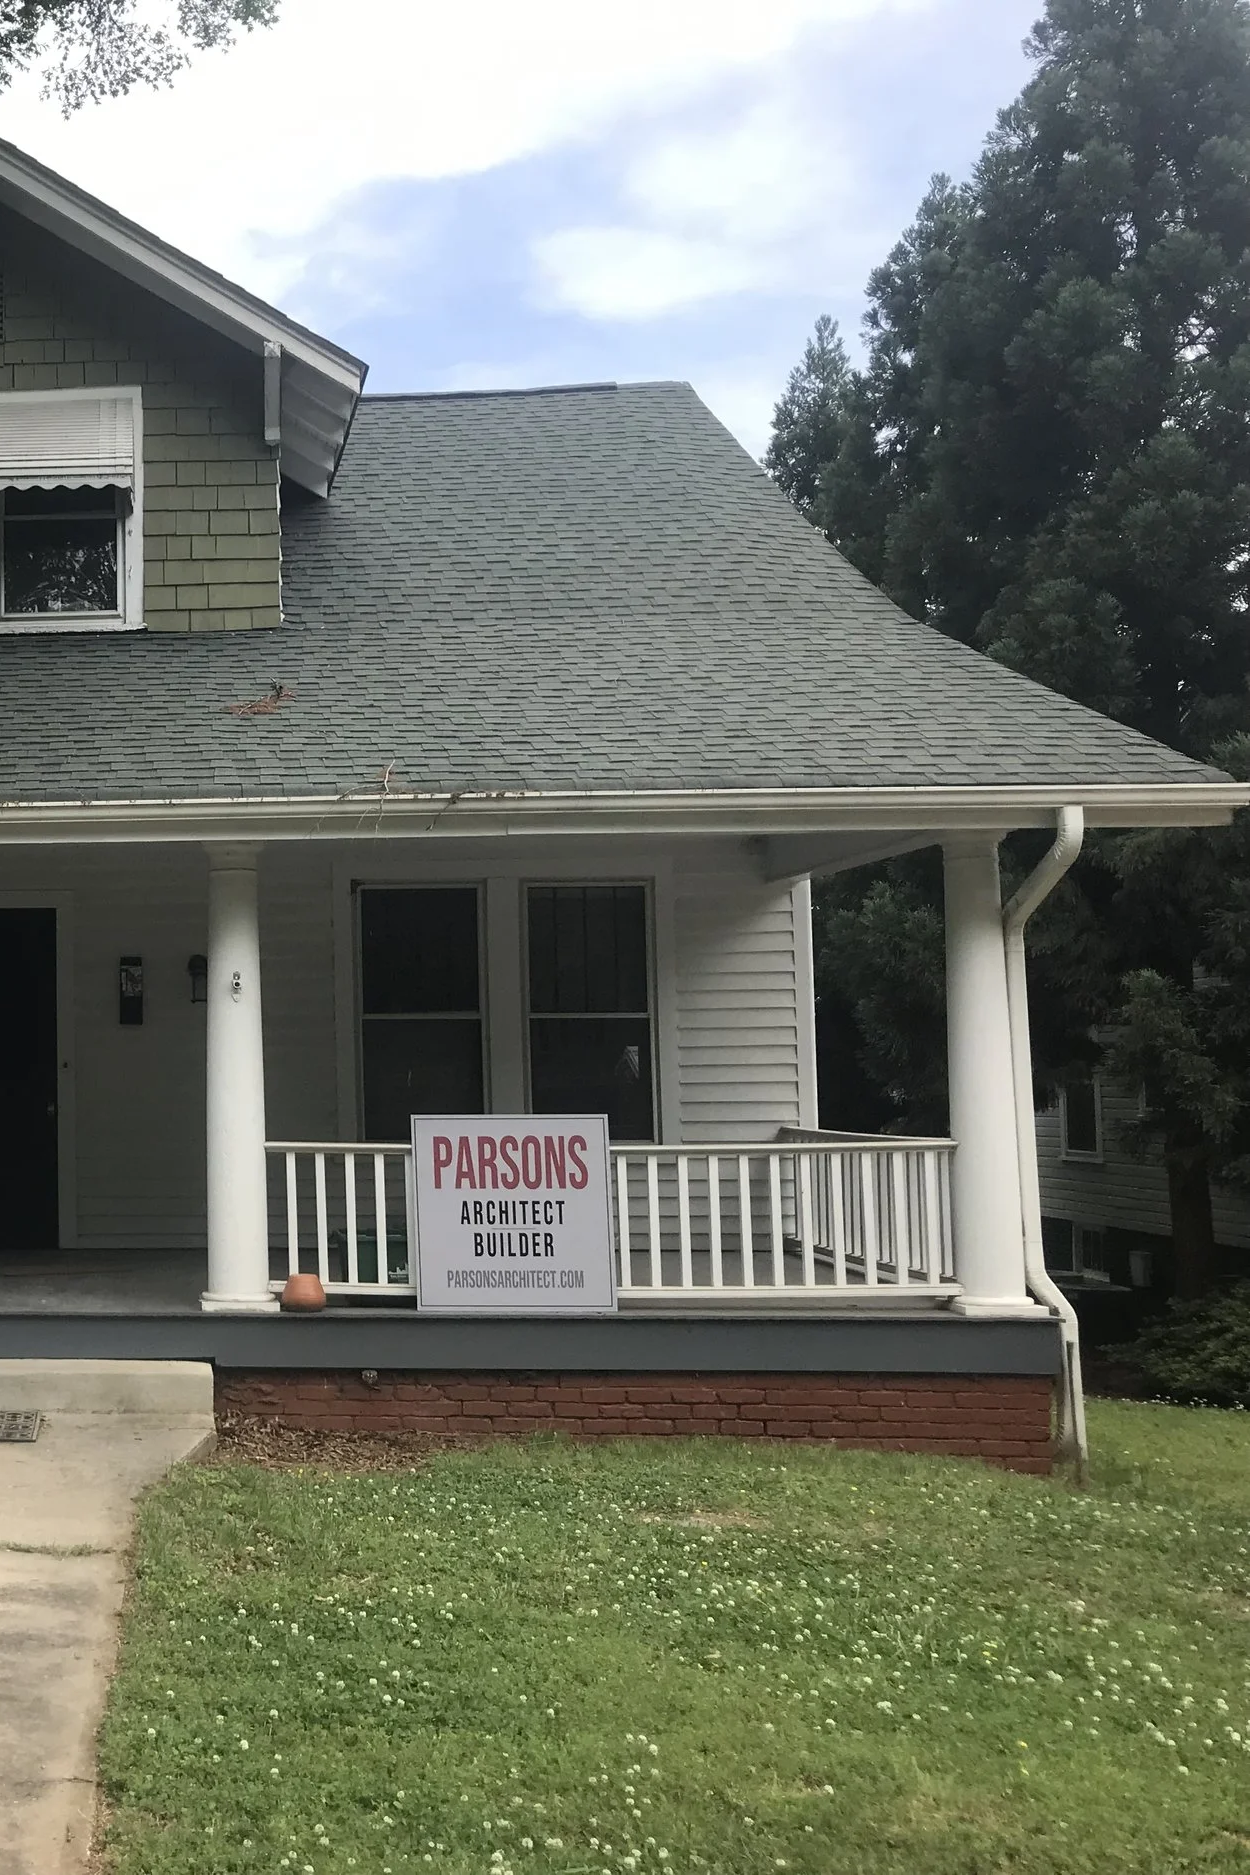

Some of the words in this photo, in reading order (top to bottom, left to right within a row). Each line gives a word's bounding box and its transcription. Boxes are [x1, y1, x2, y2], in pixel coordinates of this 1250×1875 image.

[432, 1135, 589, 1189] PARSONS
[460, 1200, 565, 1225] ARCHITECT
[474, 1232, 555, 1257] BUILDER
[447, 1269, 585, 1289] PARSONSARCHITECT.COM
